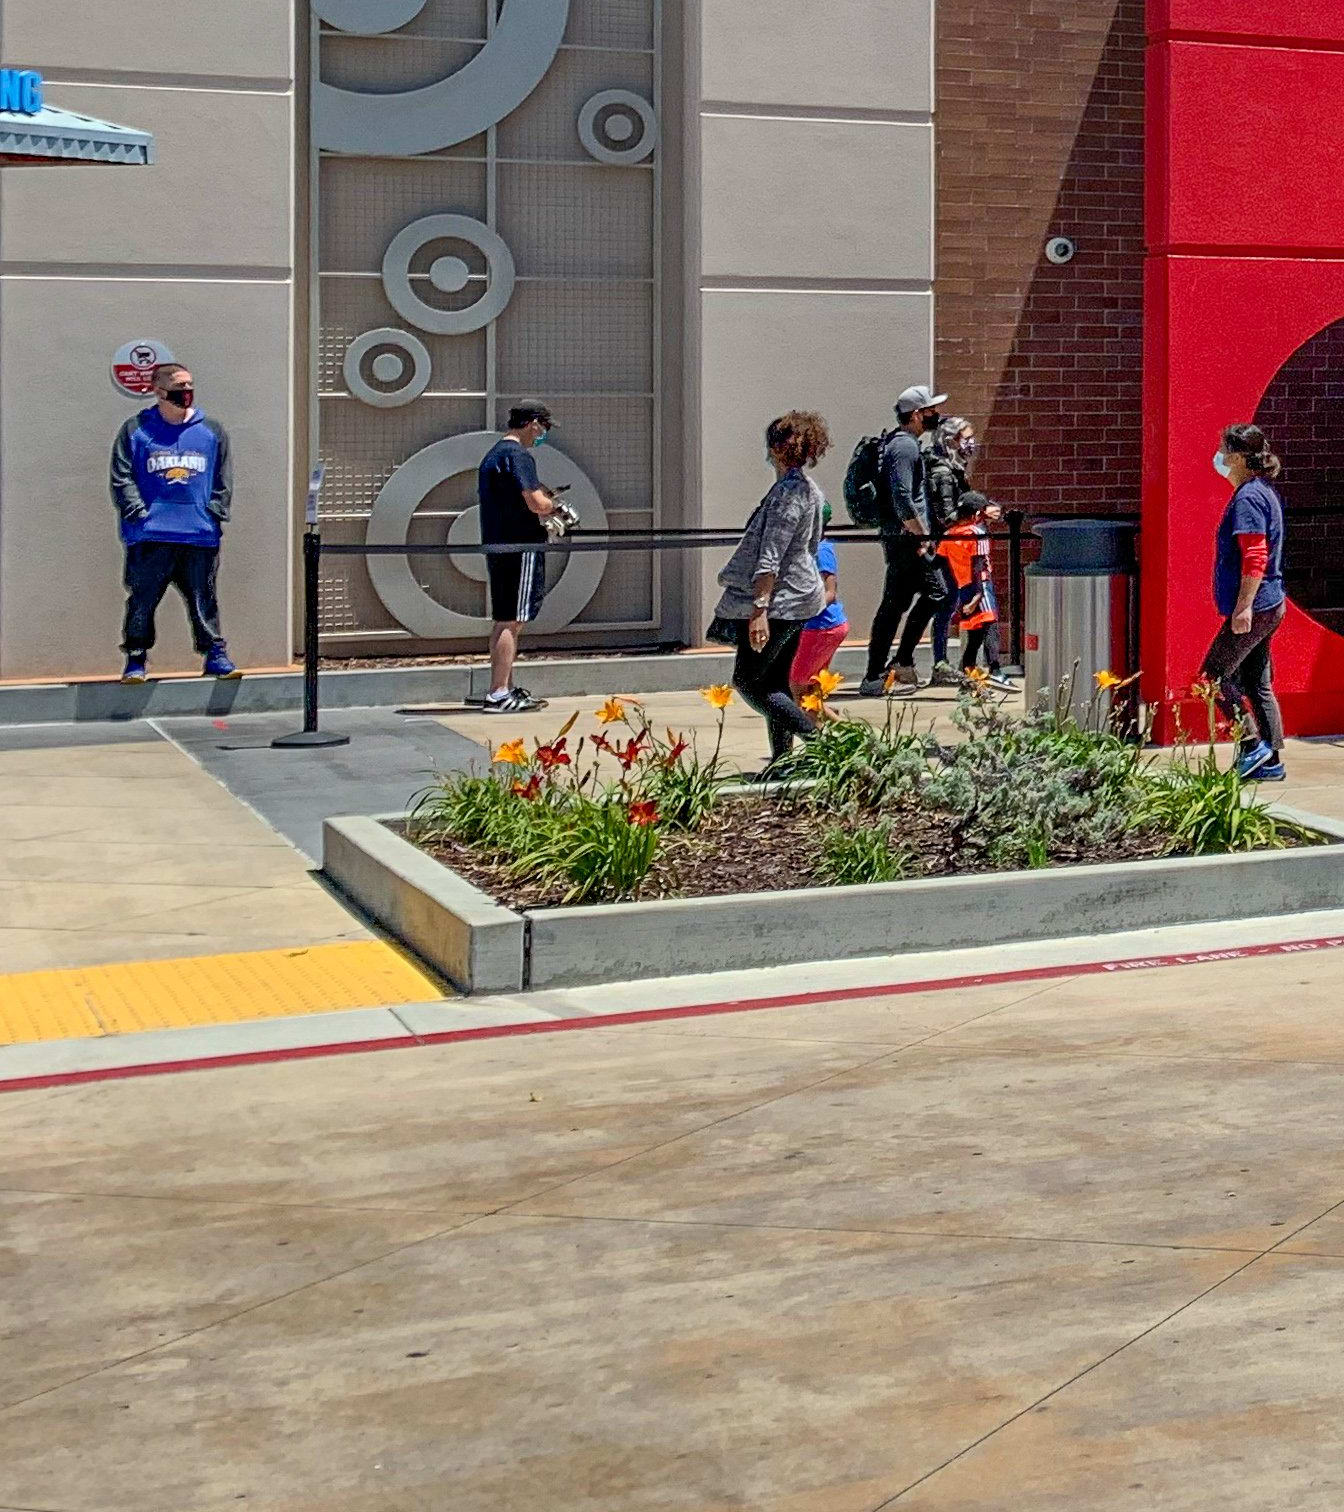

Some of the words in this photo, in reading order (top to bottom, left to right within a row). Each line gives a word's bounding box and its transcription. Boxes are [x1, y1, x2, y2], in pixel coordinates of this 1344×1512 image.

[147, 455, 206, 473] OAKLAND
[1102, 959, 1168, 970] FIRE
[1176, 951, 1248, 963] LANE
[1280, 943, 1317, 951] NO
